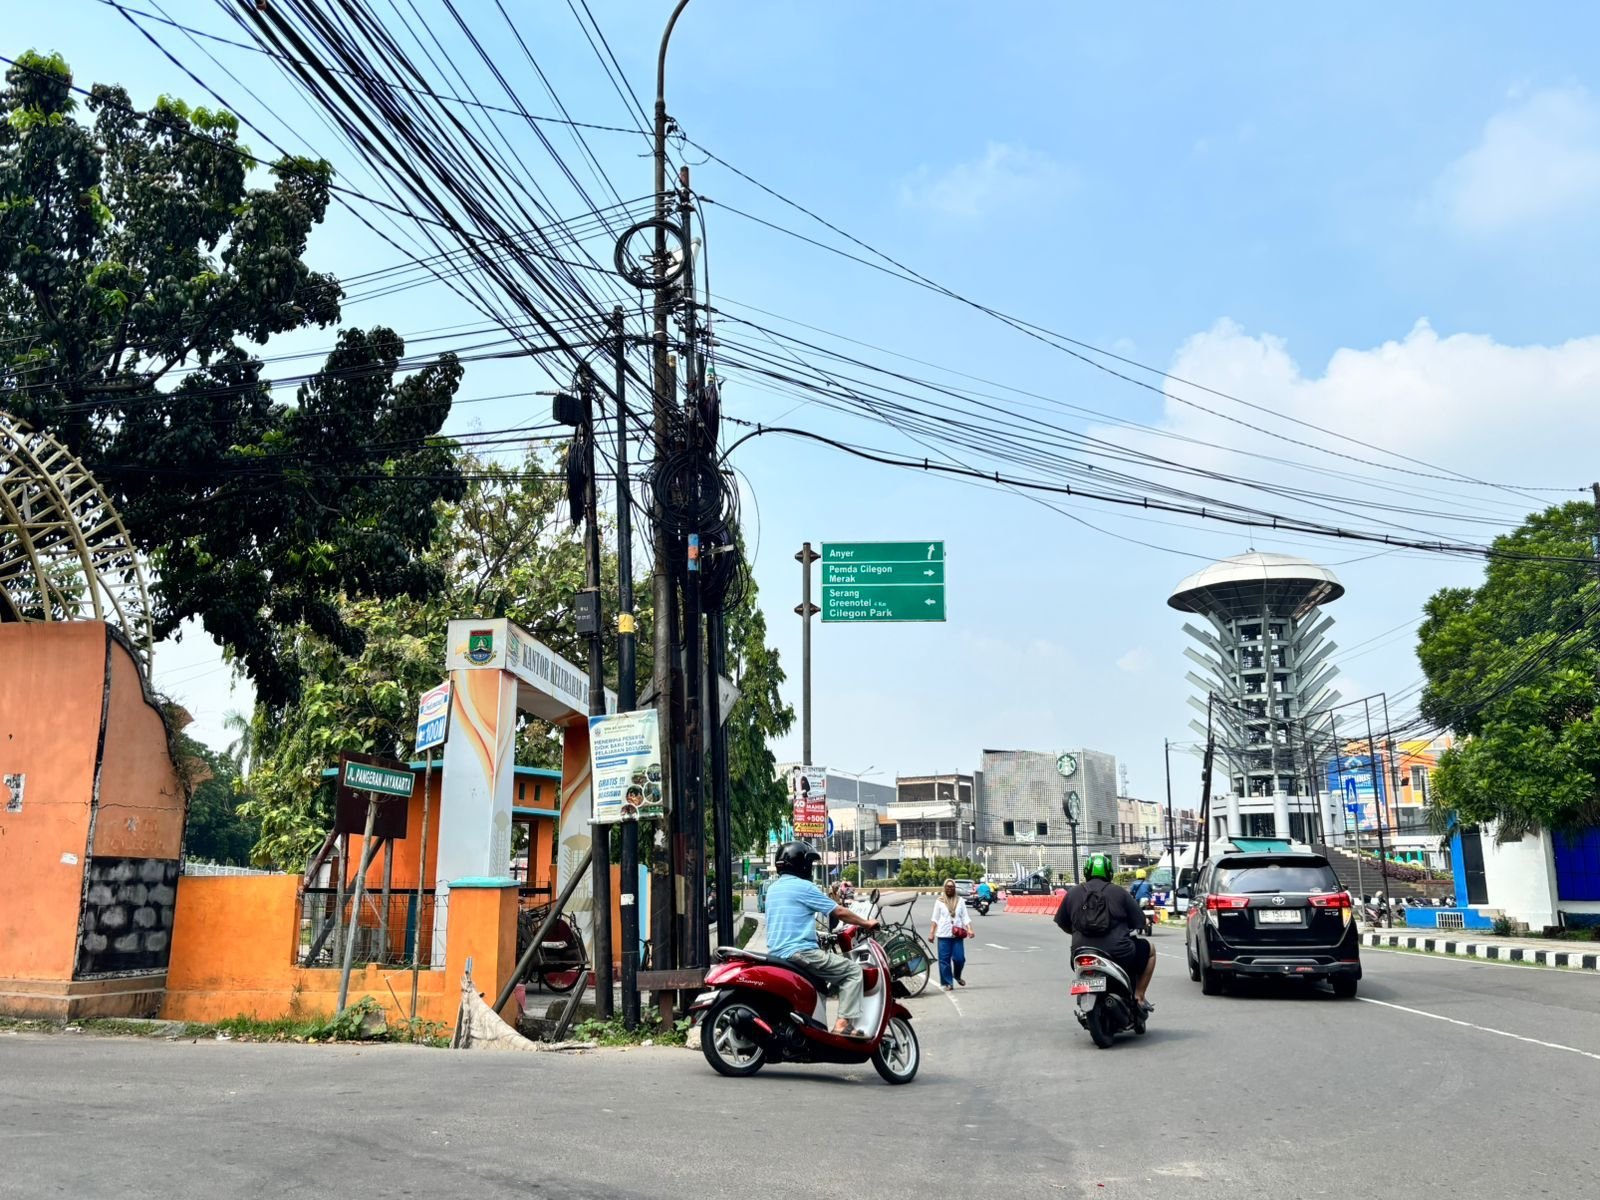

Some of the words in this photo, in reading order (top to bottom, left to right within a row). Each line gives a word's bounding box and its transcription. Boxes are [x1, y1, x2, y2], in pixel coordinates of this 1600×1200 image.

[829, 549, 854, 559] Anyer
[829, 565, 858, 573] Pemda
[860, 565, 893, 575] Cilegon
[829, 575, 856, 583] Merak
[829, 589, 860, 599] Serang
[829, 598, 872, 607] Greenotel
[829, 609, 867, 619] Cilegon
[870, 608, 892, 617] Park
[523, 643, 549, 679] KANTOR
[550, 660, 583, 701] KELURAHAN
[355, 768, 383, 786] PANGERAN
[383, 774, 411, 792] JAYAKARTA
[599, 777, 618, 787] GRATIS
